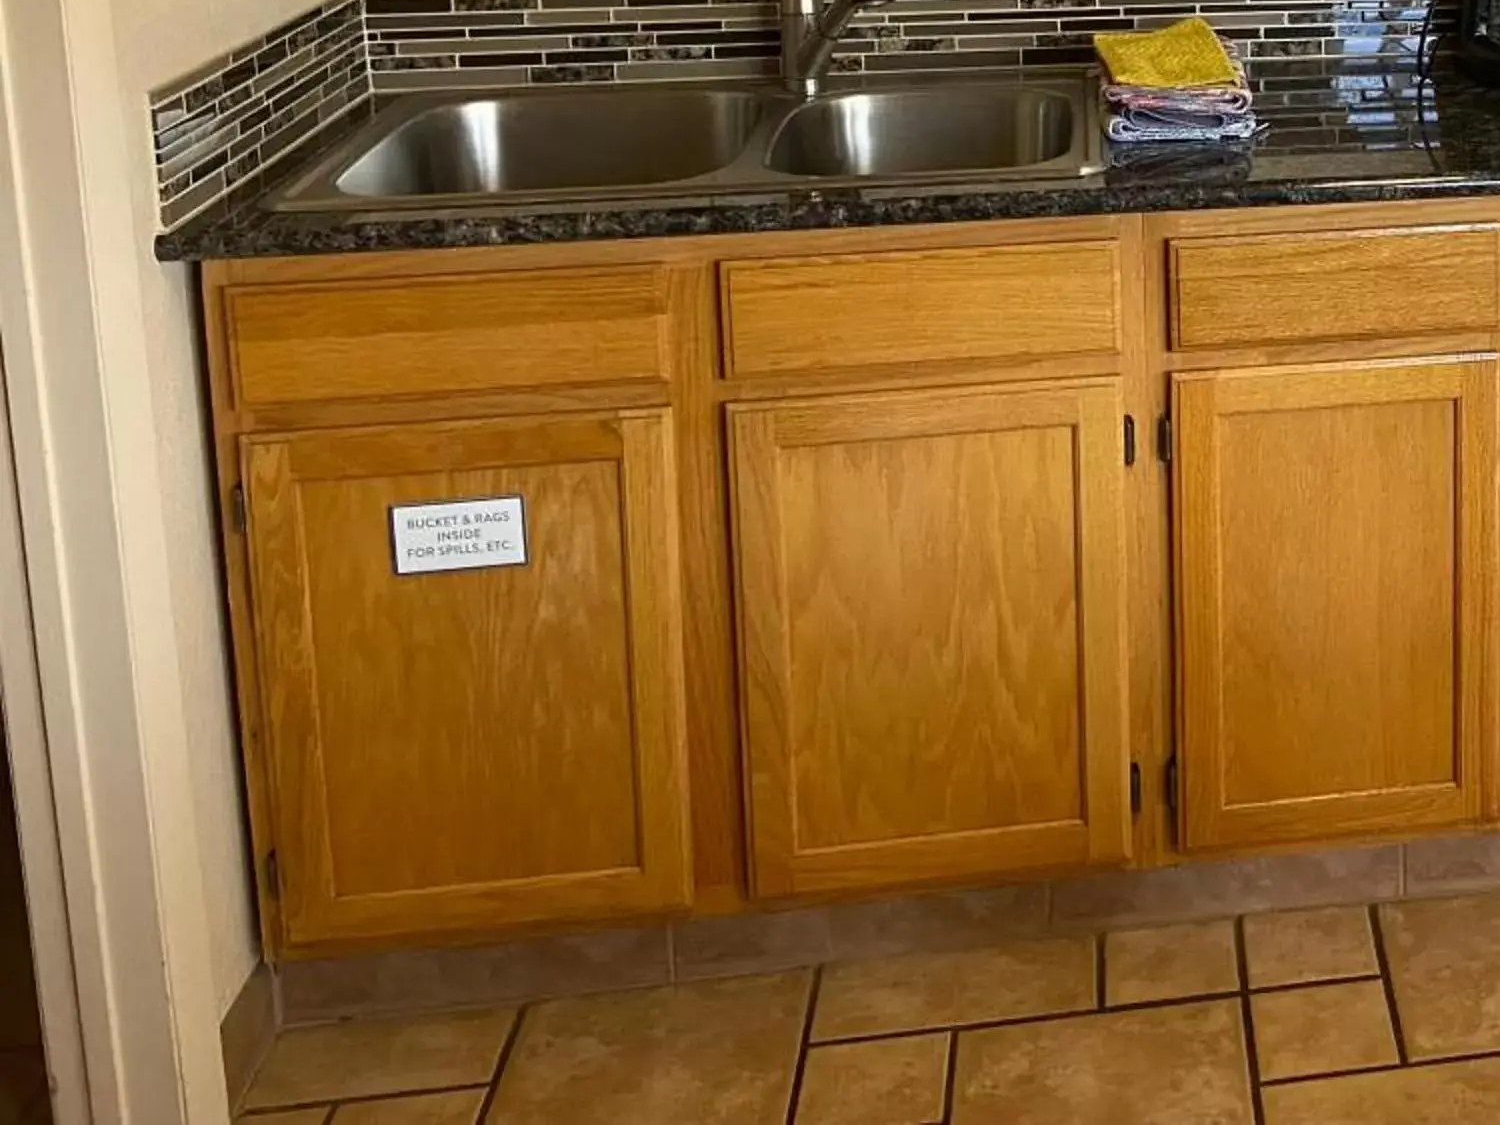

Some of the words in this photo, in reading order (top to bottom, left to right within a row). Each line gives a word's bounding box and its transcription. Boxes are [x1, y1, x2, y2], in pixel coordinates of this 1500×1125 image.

[406, 515, 457, 530] BUCKET
[462, 514, 471, 525] &
[475, 511, 511, 523] RAGS
[437, 529, 481, 542] INSIDE
[407, 546, 435, 558] FOR
[438, 543, 483, 556] SPILLS,
